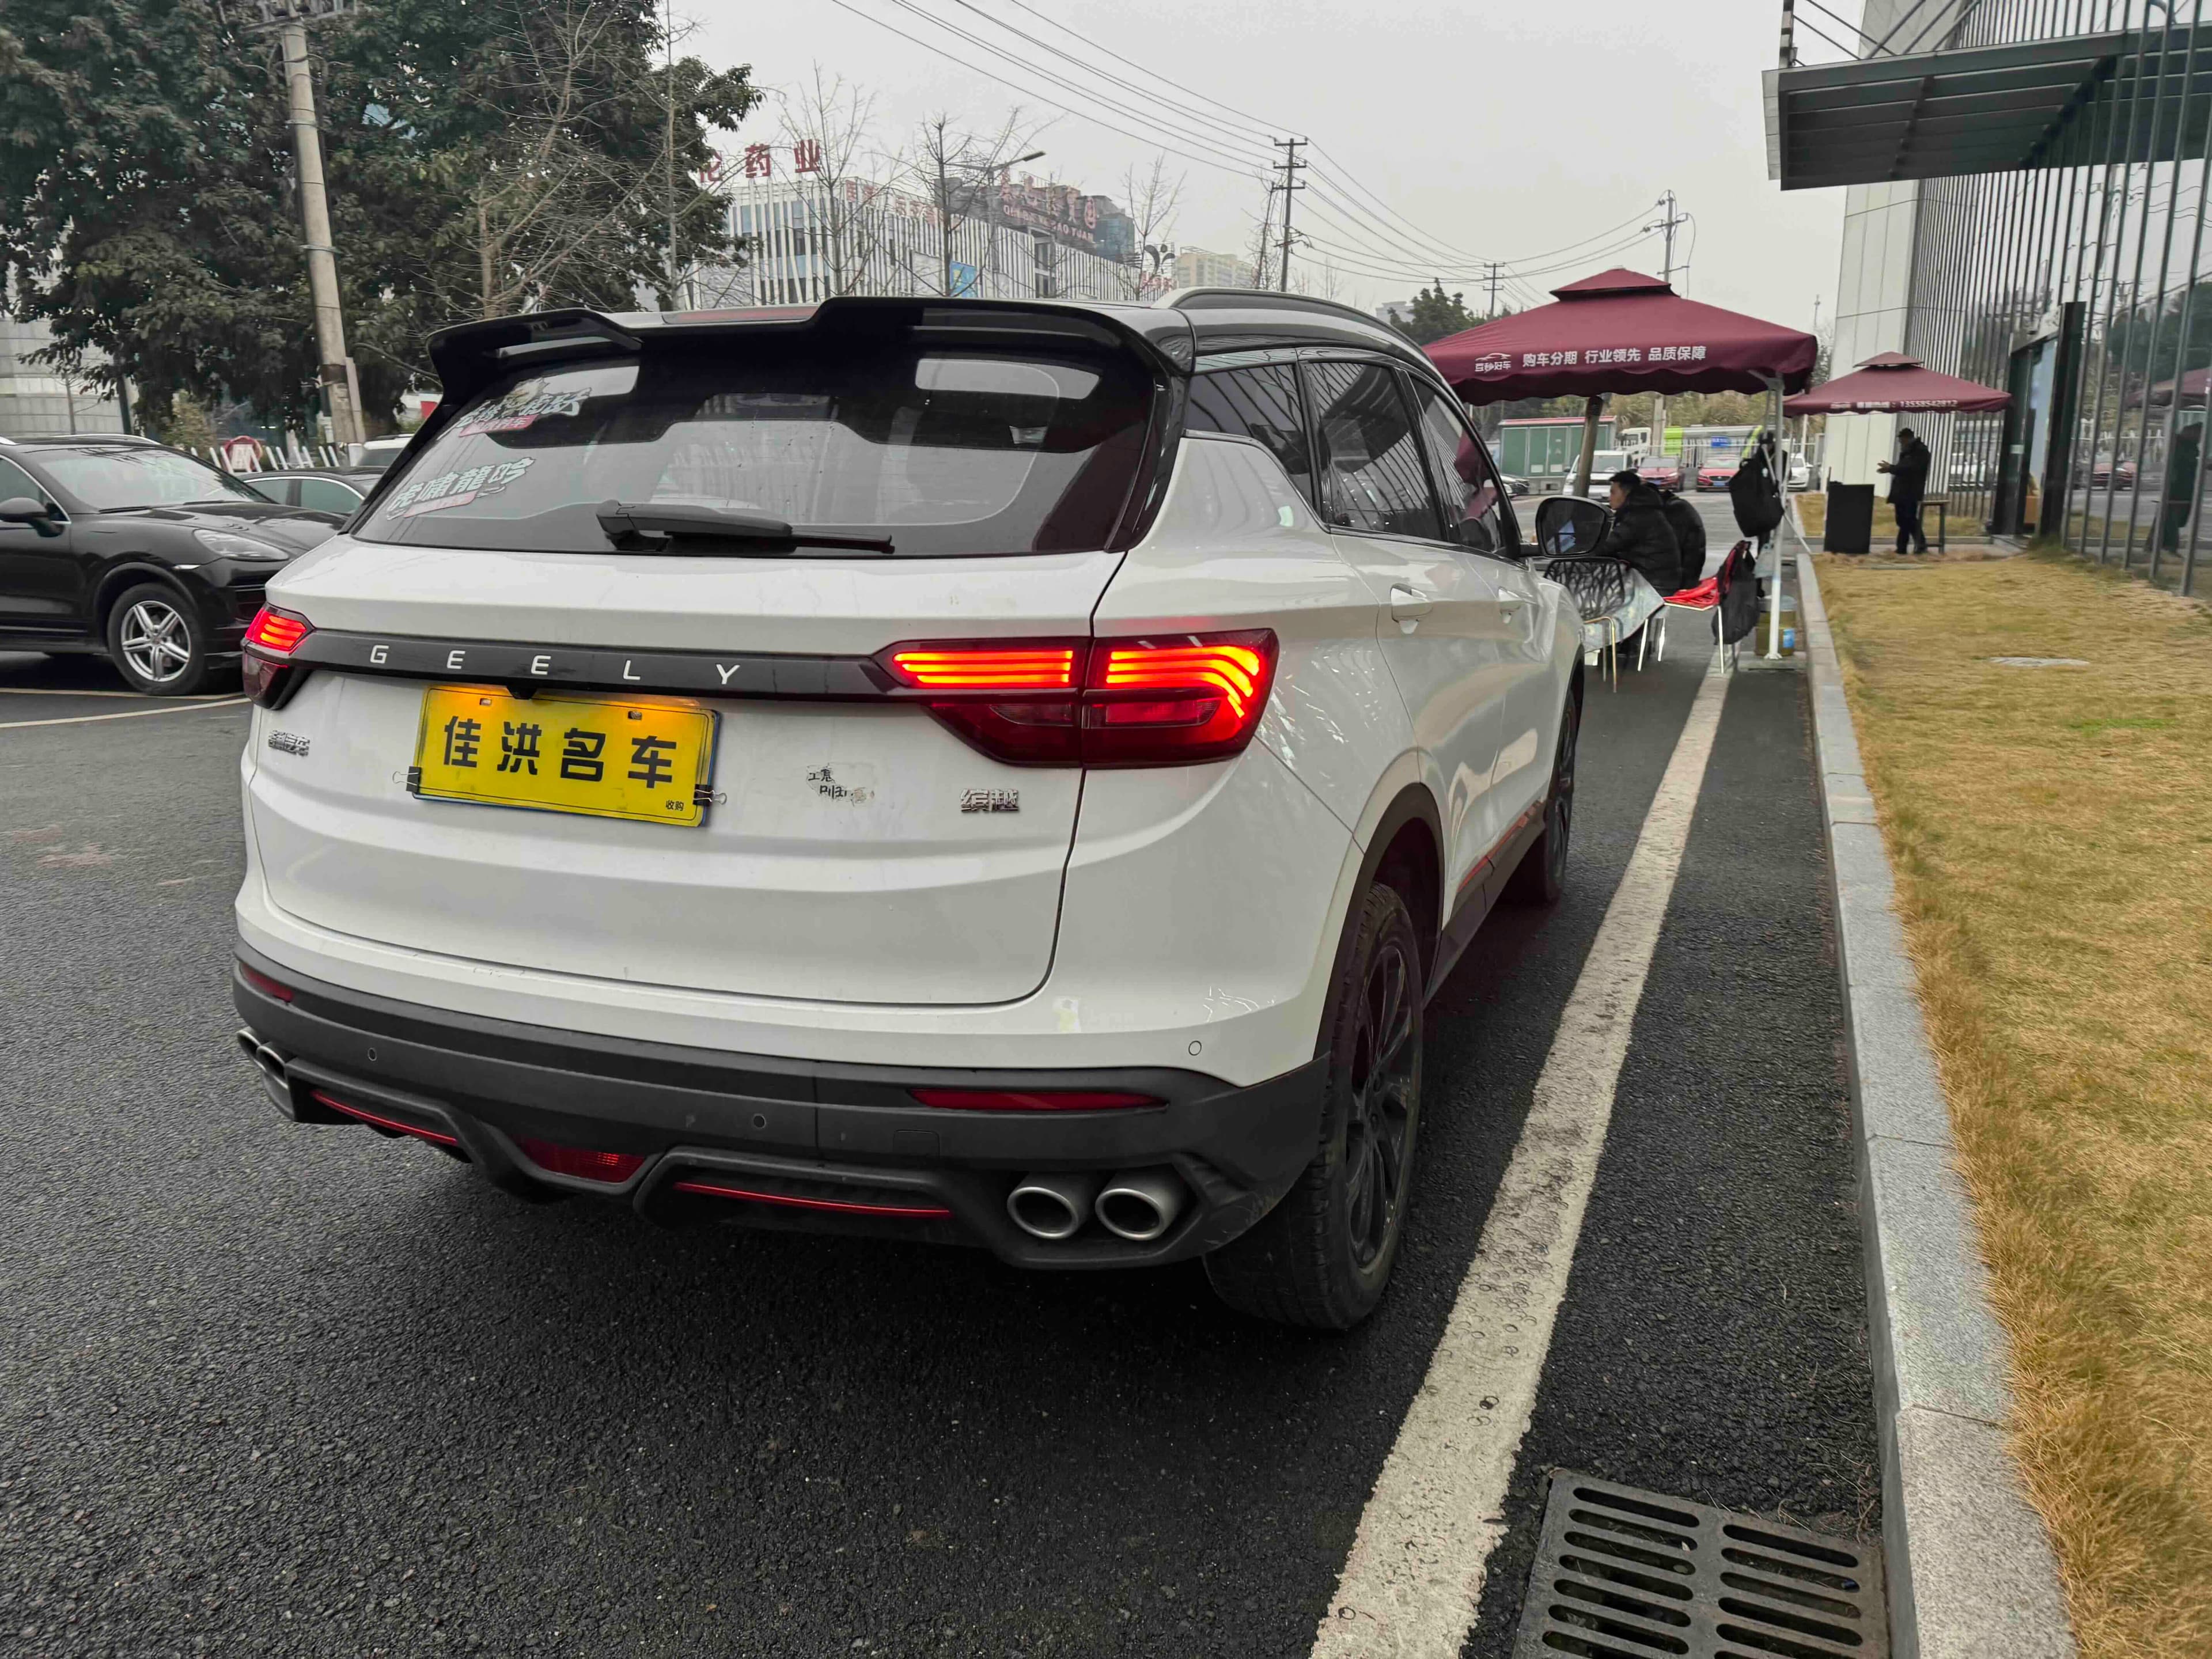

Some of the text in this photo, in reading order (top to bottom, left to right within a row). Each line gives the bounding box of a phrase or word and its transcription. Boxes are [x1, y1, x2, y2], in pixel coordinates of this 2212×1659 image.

[1522, 351, 1578, 368] 购车分期
[1584, 349, 1641, 364] 行业领先
[1648, 345, 1707, 362] 品质保障
[370, 645, 741, 685] GEELY
[443, 715, 677, 789] 佳洪名车
[665, 799, 684, 811] 收购
[960, 788, 1020, 813] 缤越
